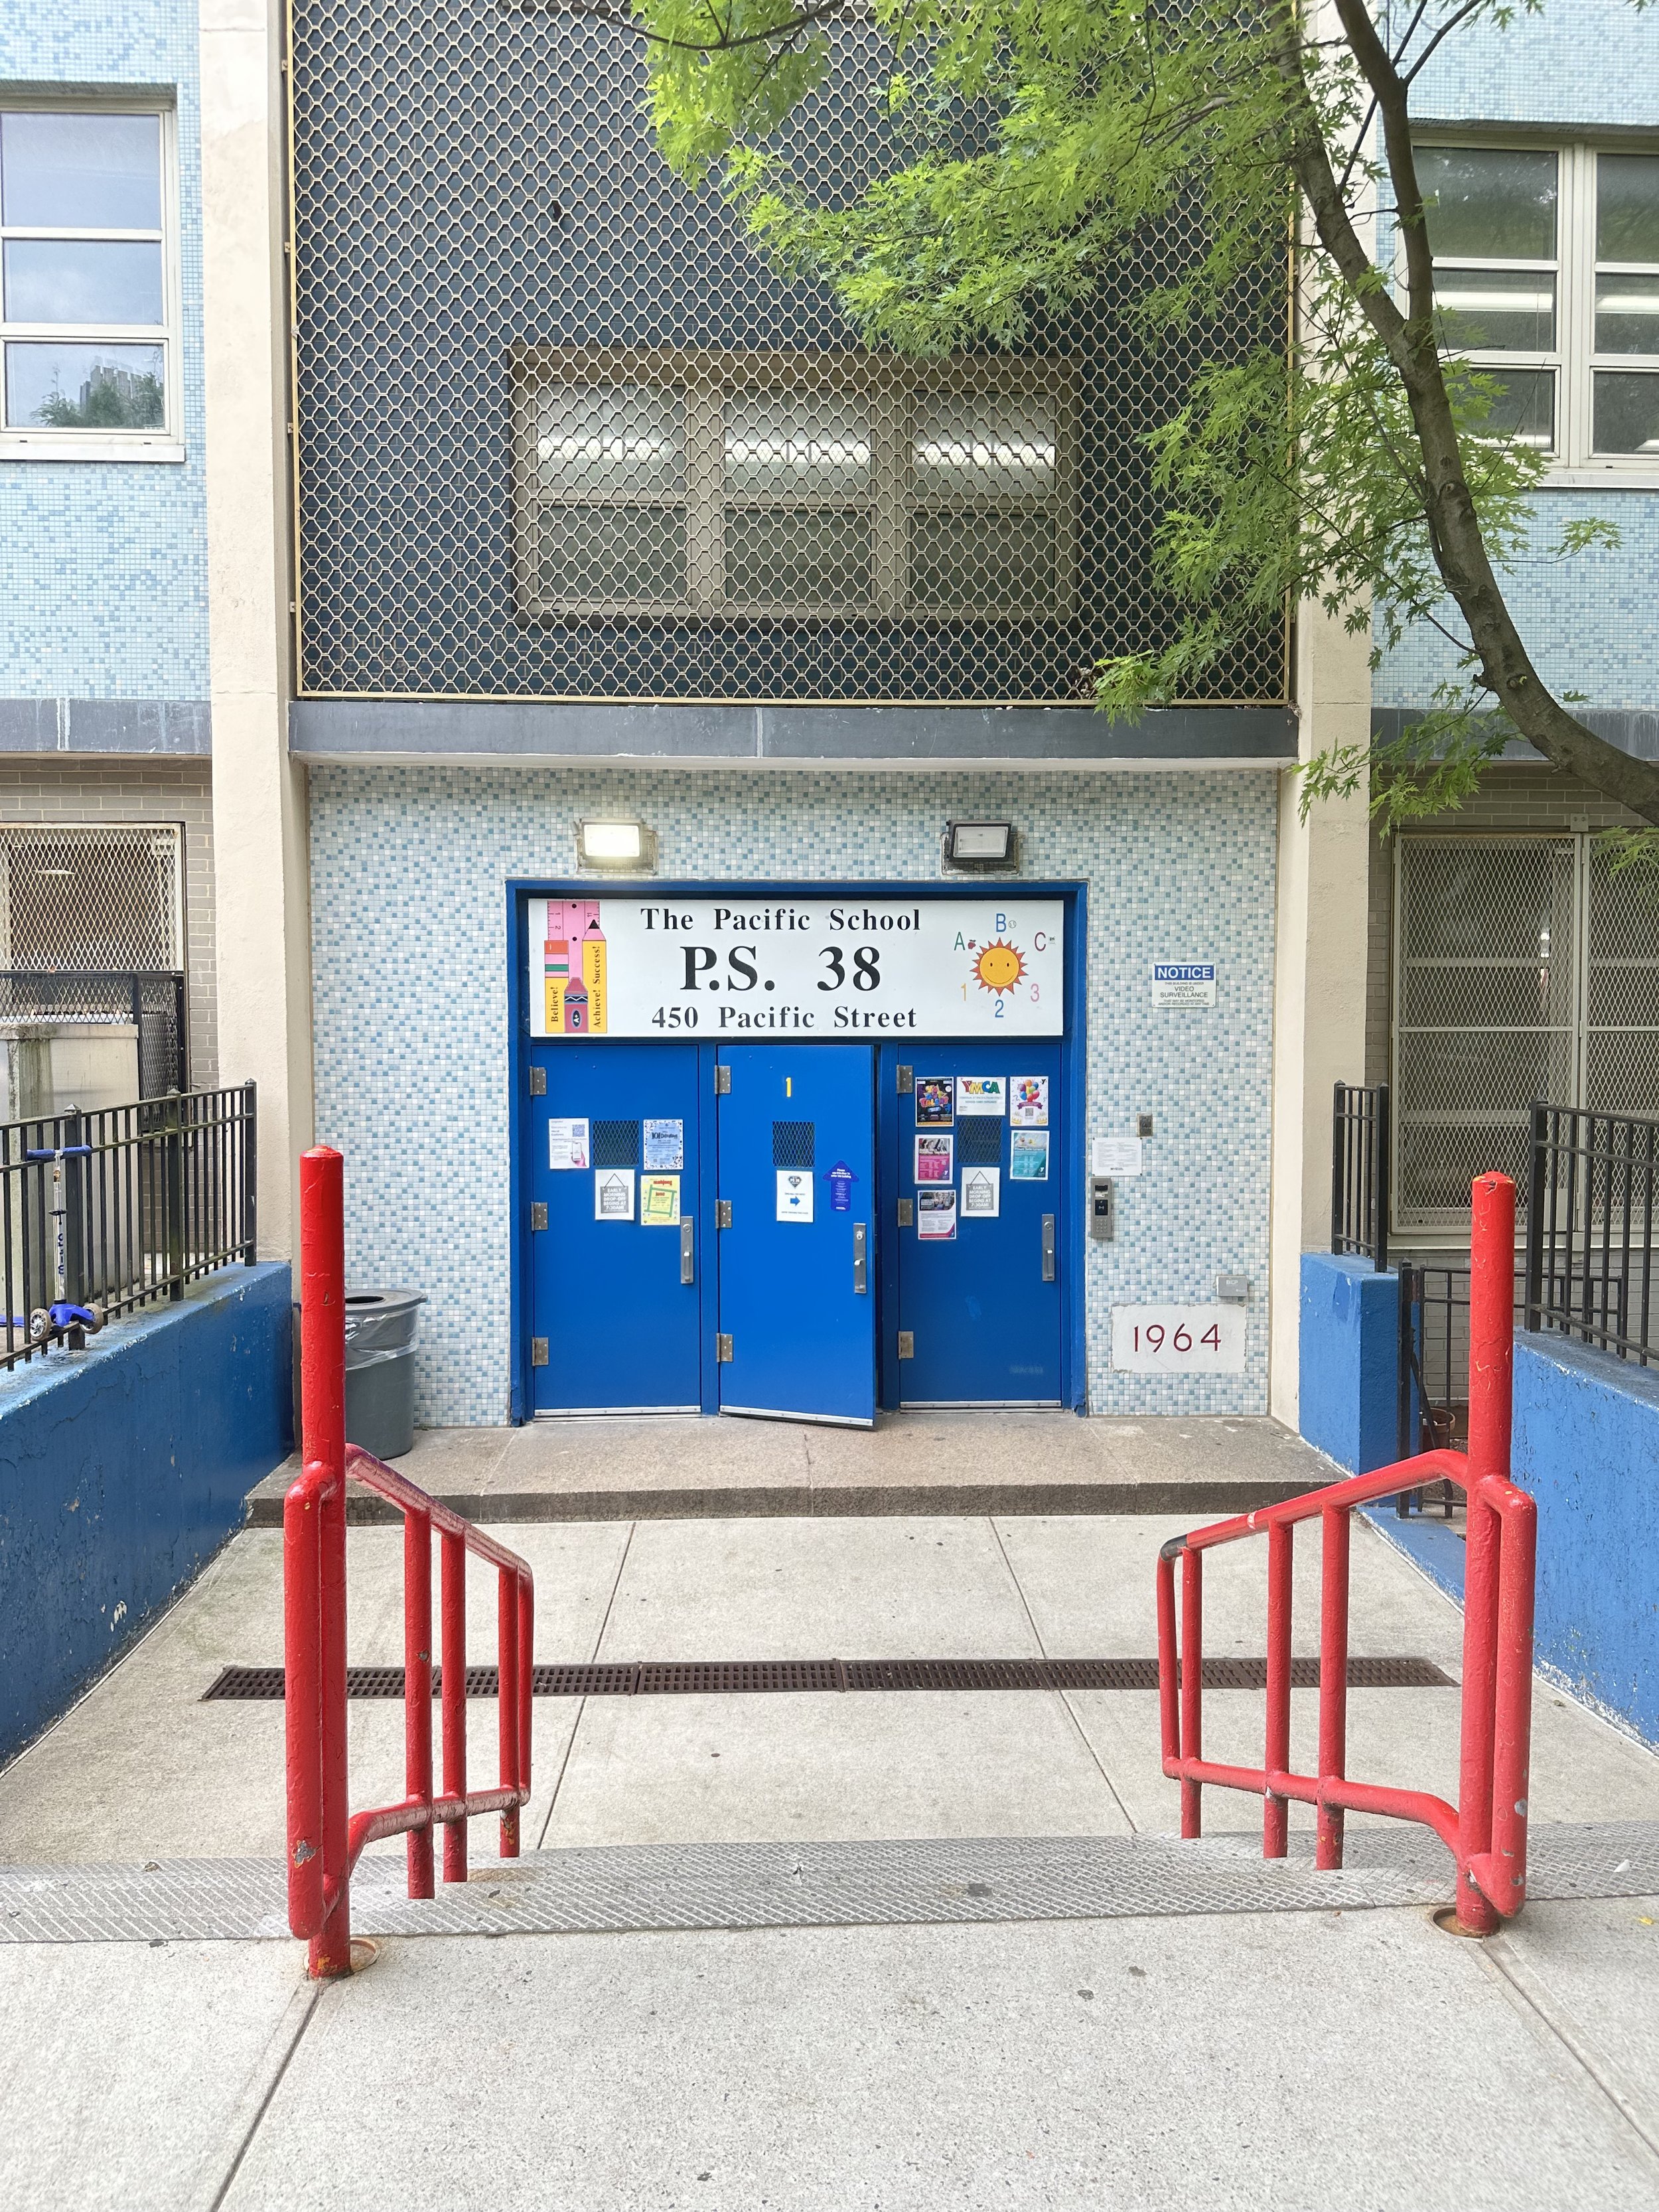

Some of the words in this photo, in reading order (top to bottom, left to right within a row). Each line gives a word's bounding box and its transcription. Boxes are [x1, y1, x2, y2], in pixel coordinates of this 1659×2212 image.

[640, 908, 694, 930] The
[713, 908, 810, 930] Pacific
[829, 908, 920, 930] School
[995, 913, 1007, 932] B
[954, 931, 966, 951] A
[1034, 932, 1046, 952] C
[592, 946, 601, 984] Success!
[680, 945, 775, 992] P.S.
[816, 946, 881, 992] 38
[1157, 967, 1211, 979] NOTICE
[960, 983, 966, 1001] 1
[1030, 983, 1040, 1002] 3
[550, 987, 559, 1023] Believe!
[593, 990, 601, 1027] Achieve!
[995, 999, 1004, 1018] 2
[573, 1013, 580, 1023] A+
[651, 1005, 699, 1029] 450
[717, 1005, 815, 1029] Pacific
[833, 1005, 917, 1029] Street
[786, 1076, 792, 1098] 1
[962, 1080, 1001, 1094] YMCA
[1133, 1323, 1222, 1353] 1964
